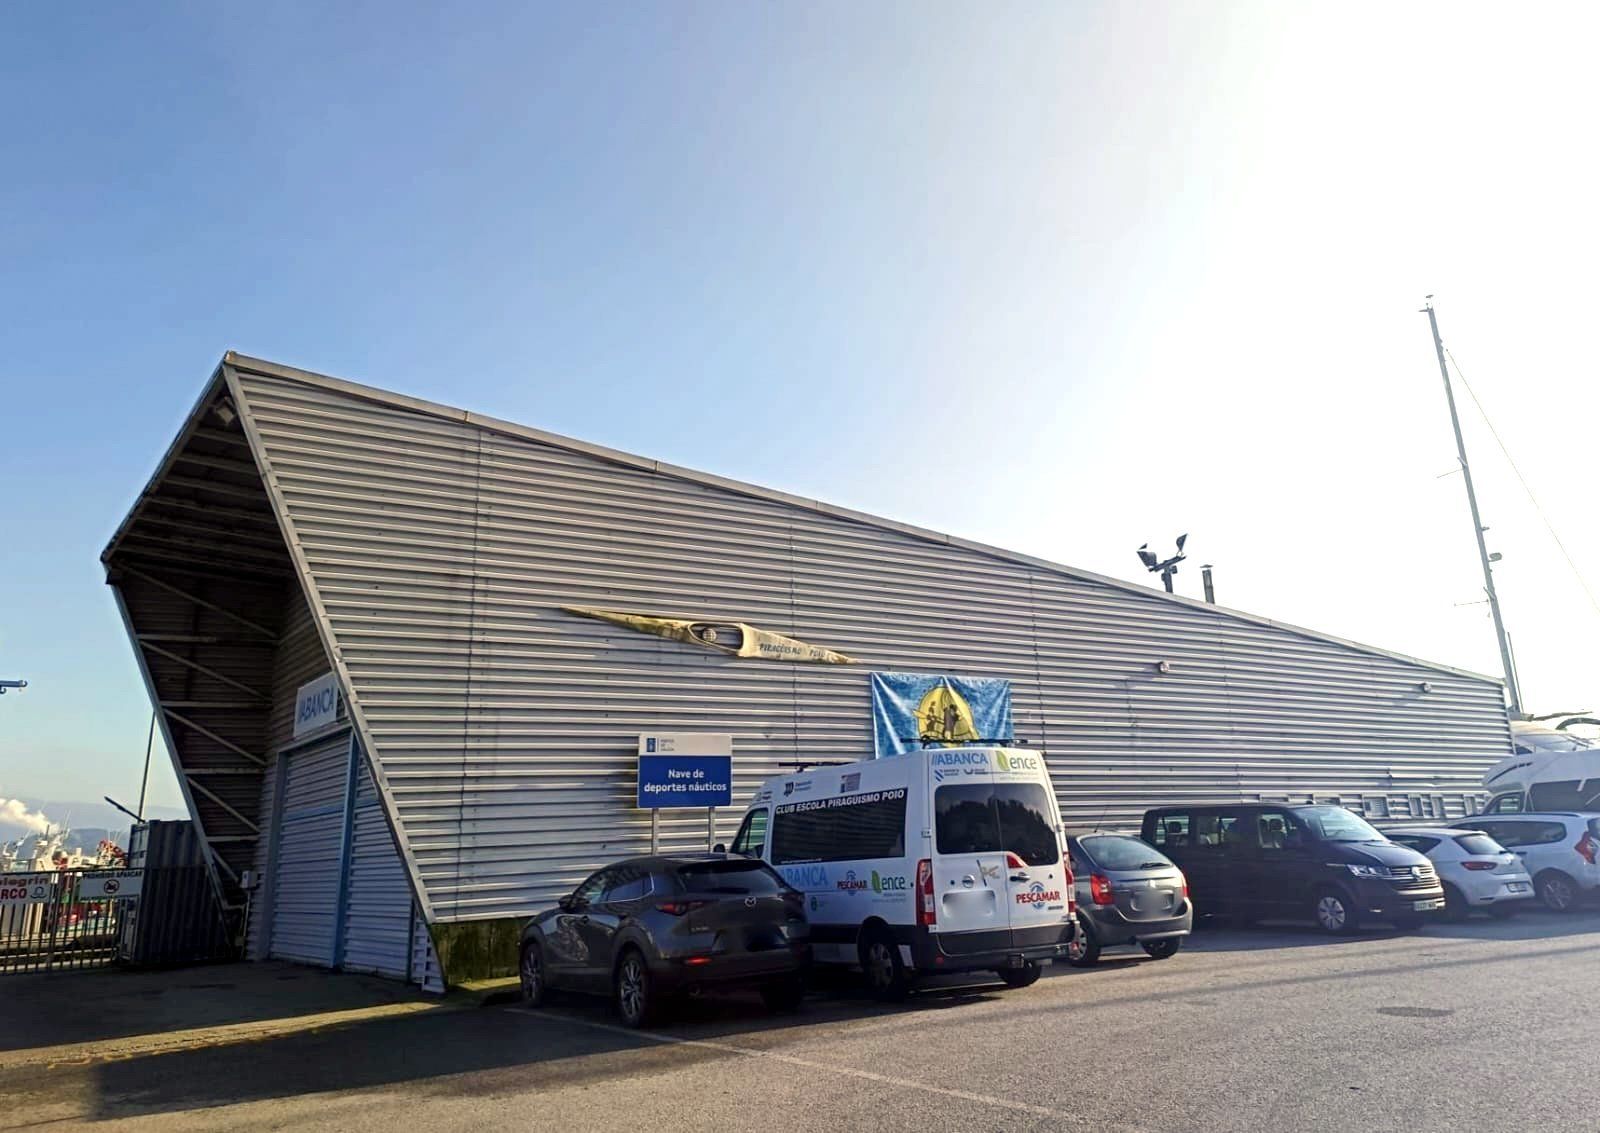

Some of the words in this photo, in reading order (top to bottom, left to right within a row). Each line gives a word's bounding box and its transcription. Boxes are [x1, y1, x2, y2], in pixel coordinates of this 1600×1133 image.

[1009, 757, 1037, 769] ence
[668, 769, 690, 778] Nave
[693, 768, 705, 779] de
[644, 783, 686, 794] deportes
[689, 781, 727, 791] náuticos
[776, 806, 795, 815] CLUB
[797, 802, 826, 812] ESCOLA
[882, 790, 904, 801] POIO
[881, 877, 905, 890] ence
[1015, 890, 1061, 904] PESCAMAR
